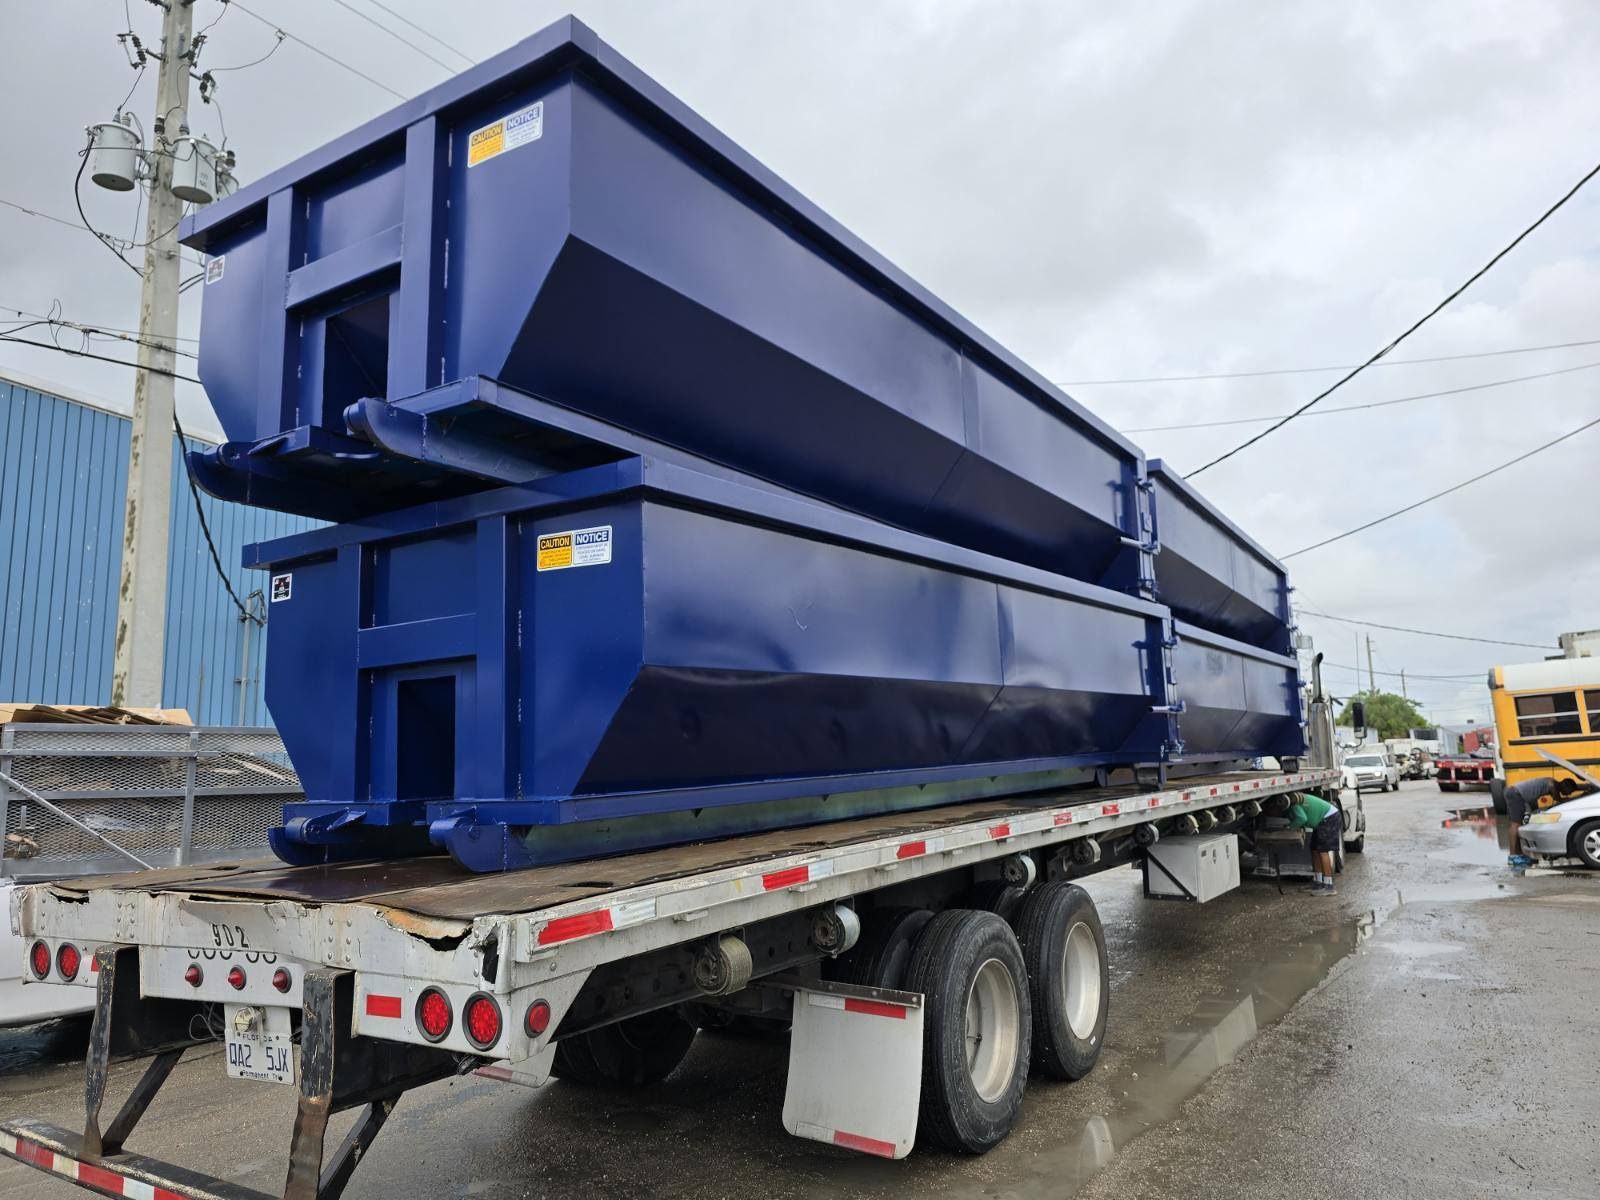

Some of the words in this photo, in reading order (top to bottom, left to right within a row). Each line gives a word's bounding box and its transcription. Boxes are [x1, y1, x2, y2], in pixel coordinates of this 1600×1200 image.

[508, 109, 538, 129] NOTICE
[472, 124, 503, 146] CAUTION
[540, 537, 570, 549] CAUTION
[576, 530, 608, 544] NOTICE
[212, 923, 249, 949] 902
[242, 1033, 273, 1042] FLORDA
[229, 1042, 252, 1068] QA2
[265, 1046, 289, 1073] 5JX
